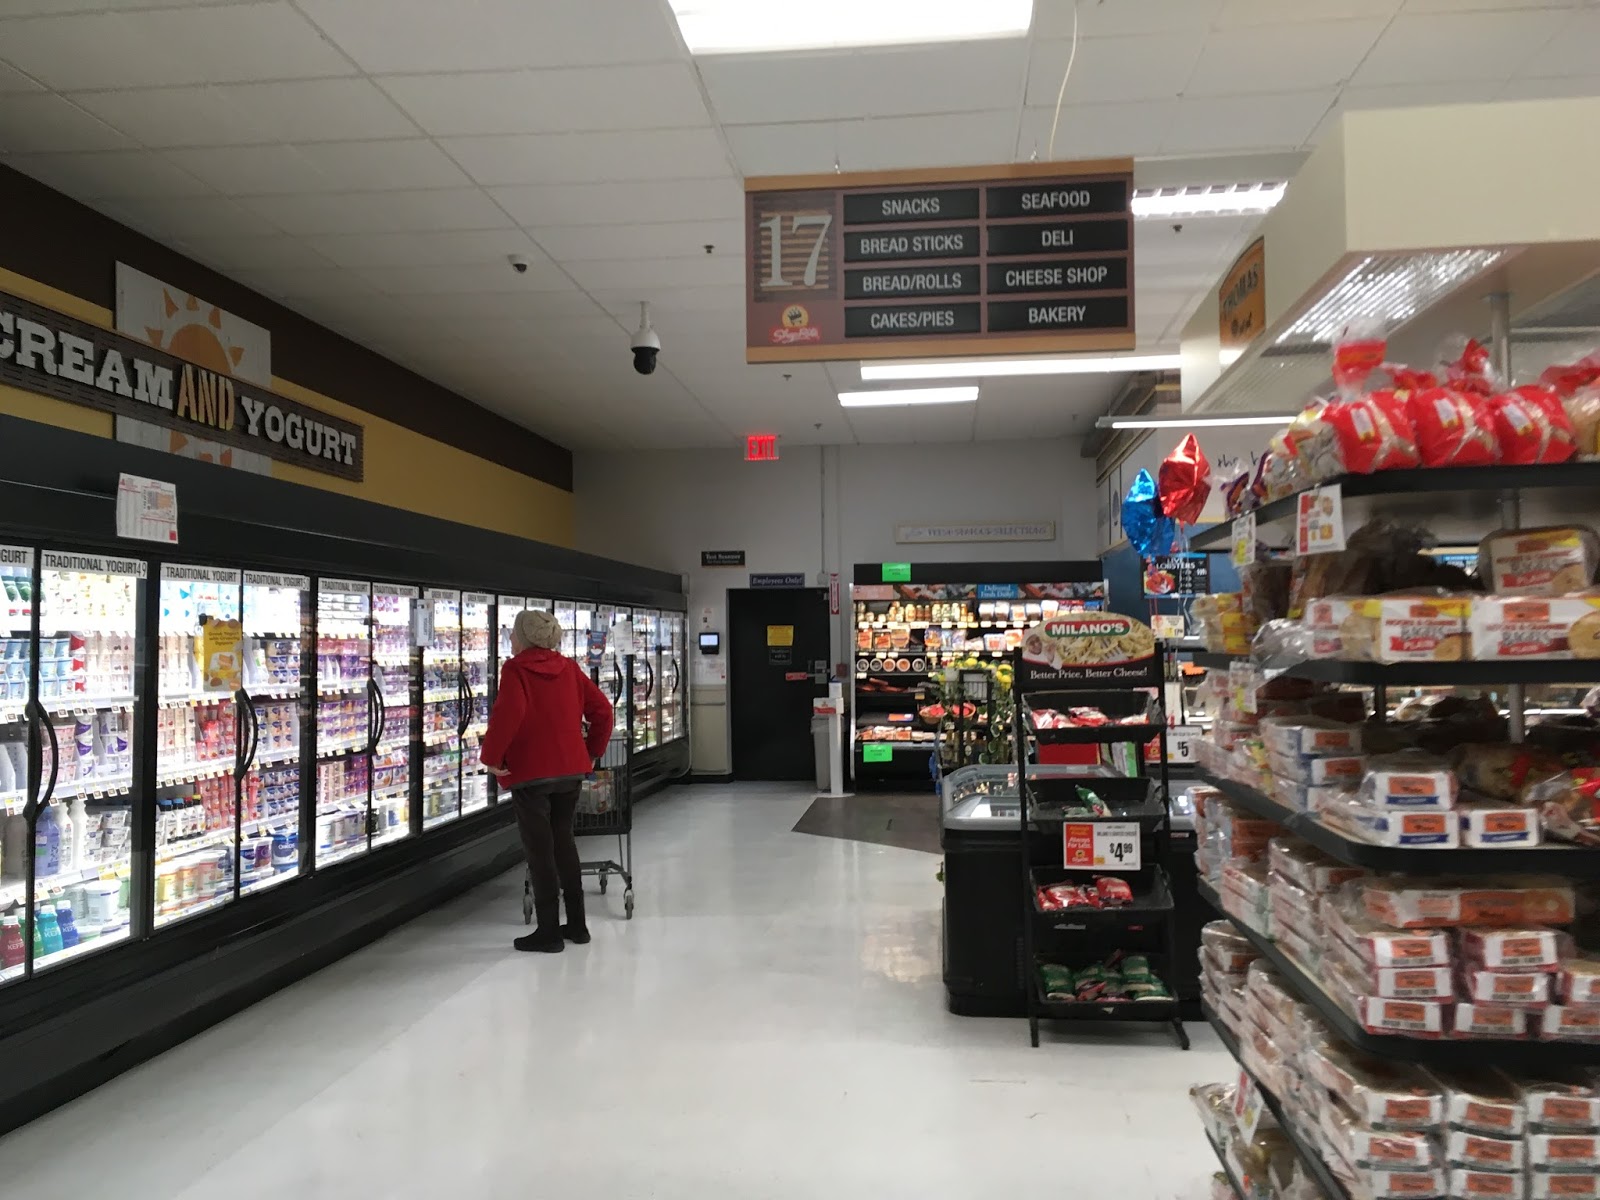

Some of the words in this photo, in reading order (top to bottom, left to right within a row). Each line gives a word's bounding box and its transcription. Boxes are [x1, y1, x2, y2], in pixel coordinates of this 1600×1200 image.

[882, 197, 940, 215] SNACKS
[1021, 190, 1090, 210] SEAFOOD
[860, 236, 908, 255] BREAD
[912, 233, 964, 252] STICKS
[1041, 229, 1073, 247] DELI
[759, 213, 833, 287] 17
[862, 272, 962, 291] BREAD/ROLLS
[1005, 268, 1063, 286] CHEESE
[1066, 265, 1108, 284] SHOP
[870, 310, 955, 329] CAKES/PIES
[1028, 305, 1086, 324] BAKERY
[177, 363, 235, 431] AND
[241, 395, 356, 465] YOGURT
[747, 435, 776, 459] EXIT
[44, 553, 104, 572] TRADITIONAL
[105, 559, 138, 575] YOGURT
[165, 566, 211, 581] TRADITIONAL
[211, 570, 238, 583] YOGURT
[245, 573, 282, 587] TRADITIONAL
[752, 577, 784, 586] Employees
[1051, 622, 1125, 636] MILANO'S
[1030, 669, 1057, 680] Better
[1059, 669, 1083, 679] Price,
[1085, 668, 1112, 678] Better
[1113, 666, 1148, 677] Cheese!
